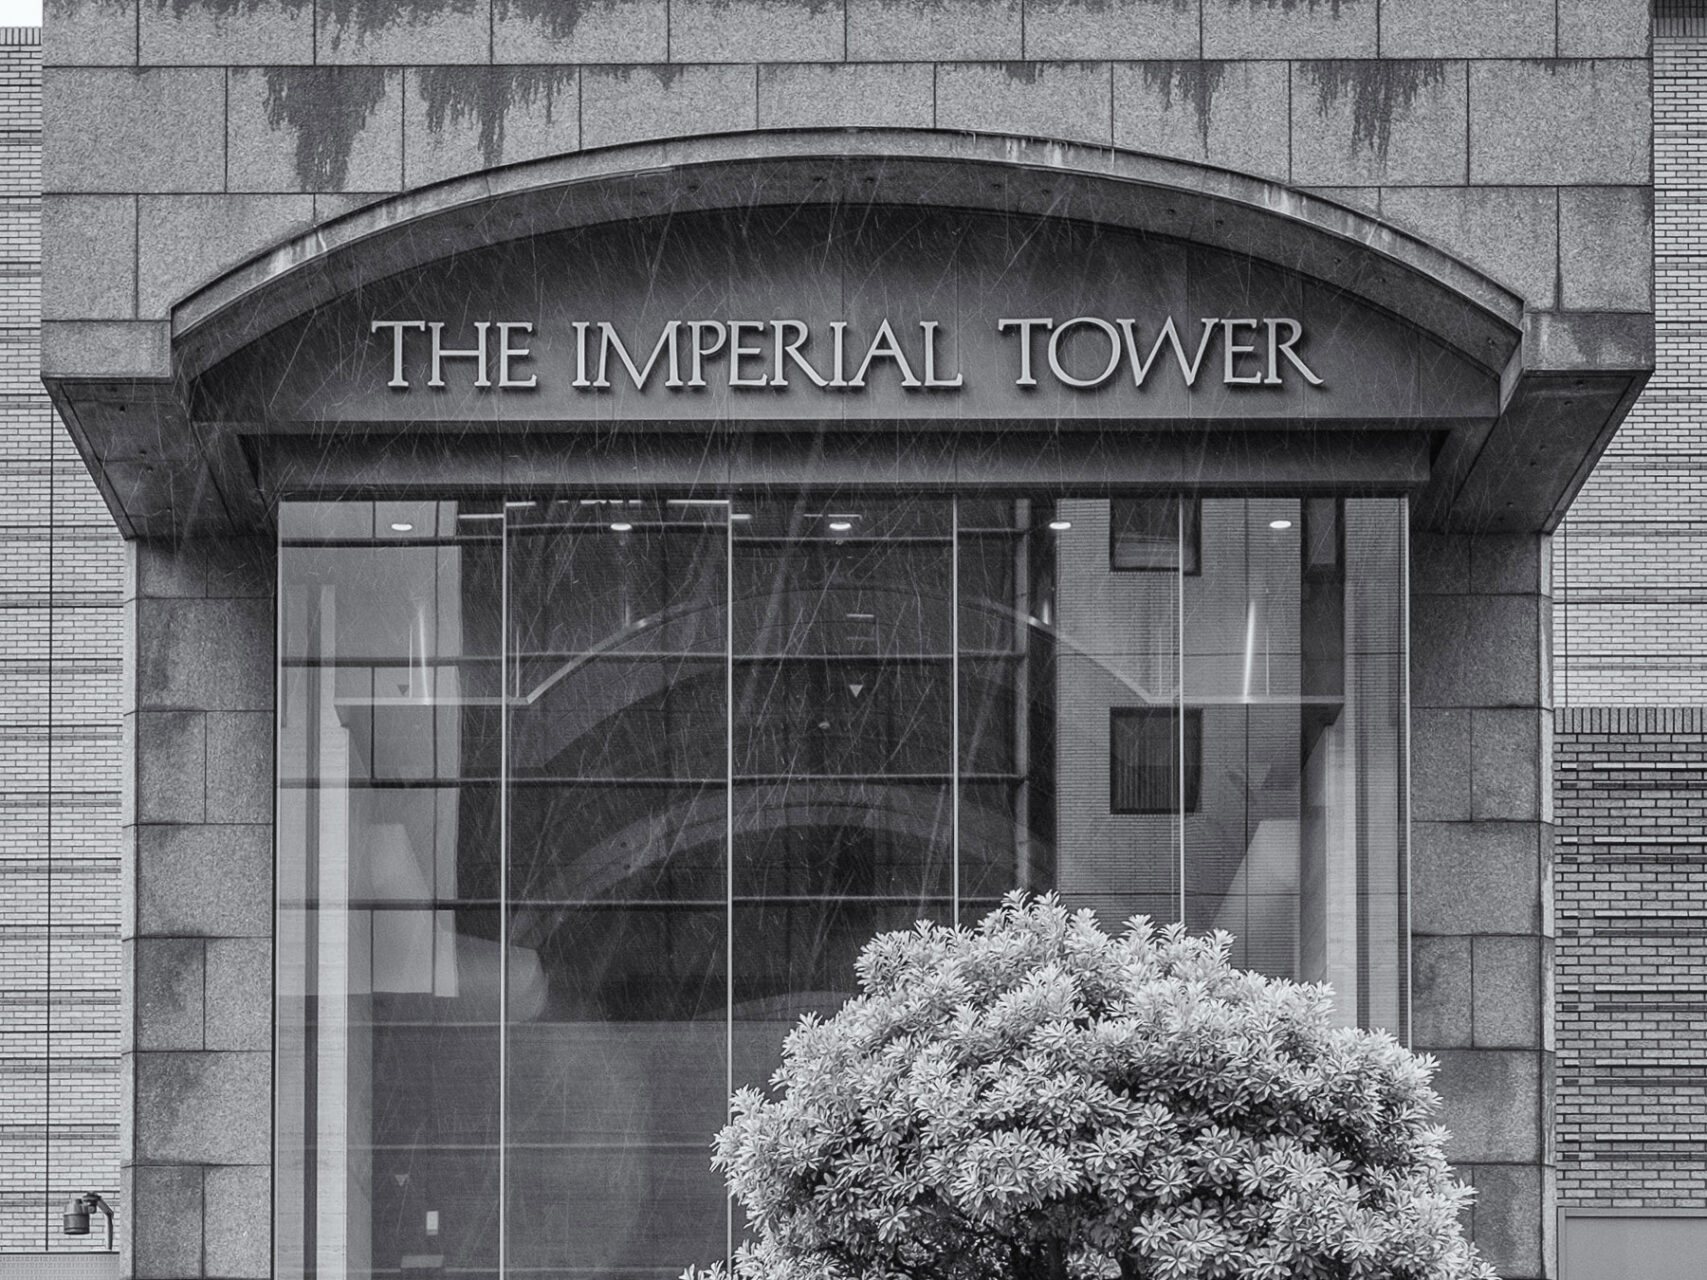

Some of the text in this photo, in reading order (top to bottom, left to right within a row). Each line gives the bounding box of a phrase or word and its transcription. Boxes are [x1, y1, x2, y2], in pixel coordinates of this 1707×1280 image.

[371, 315, 1324, 389] THE IMPERIAL TOWER
